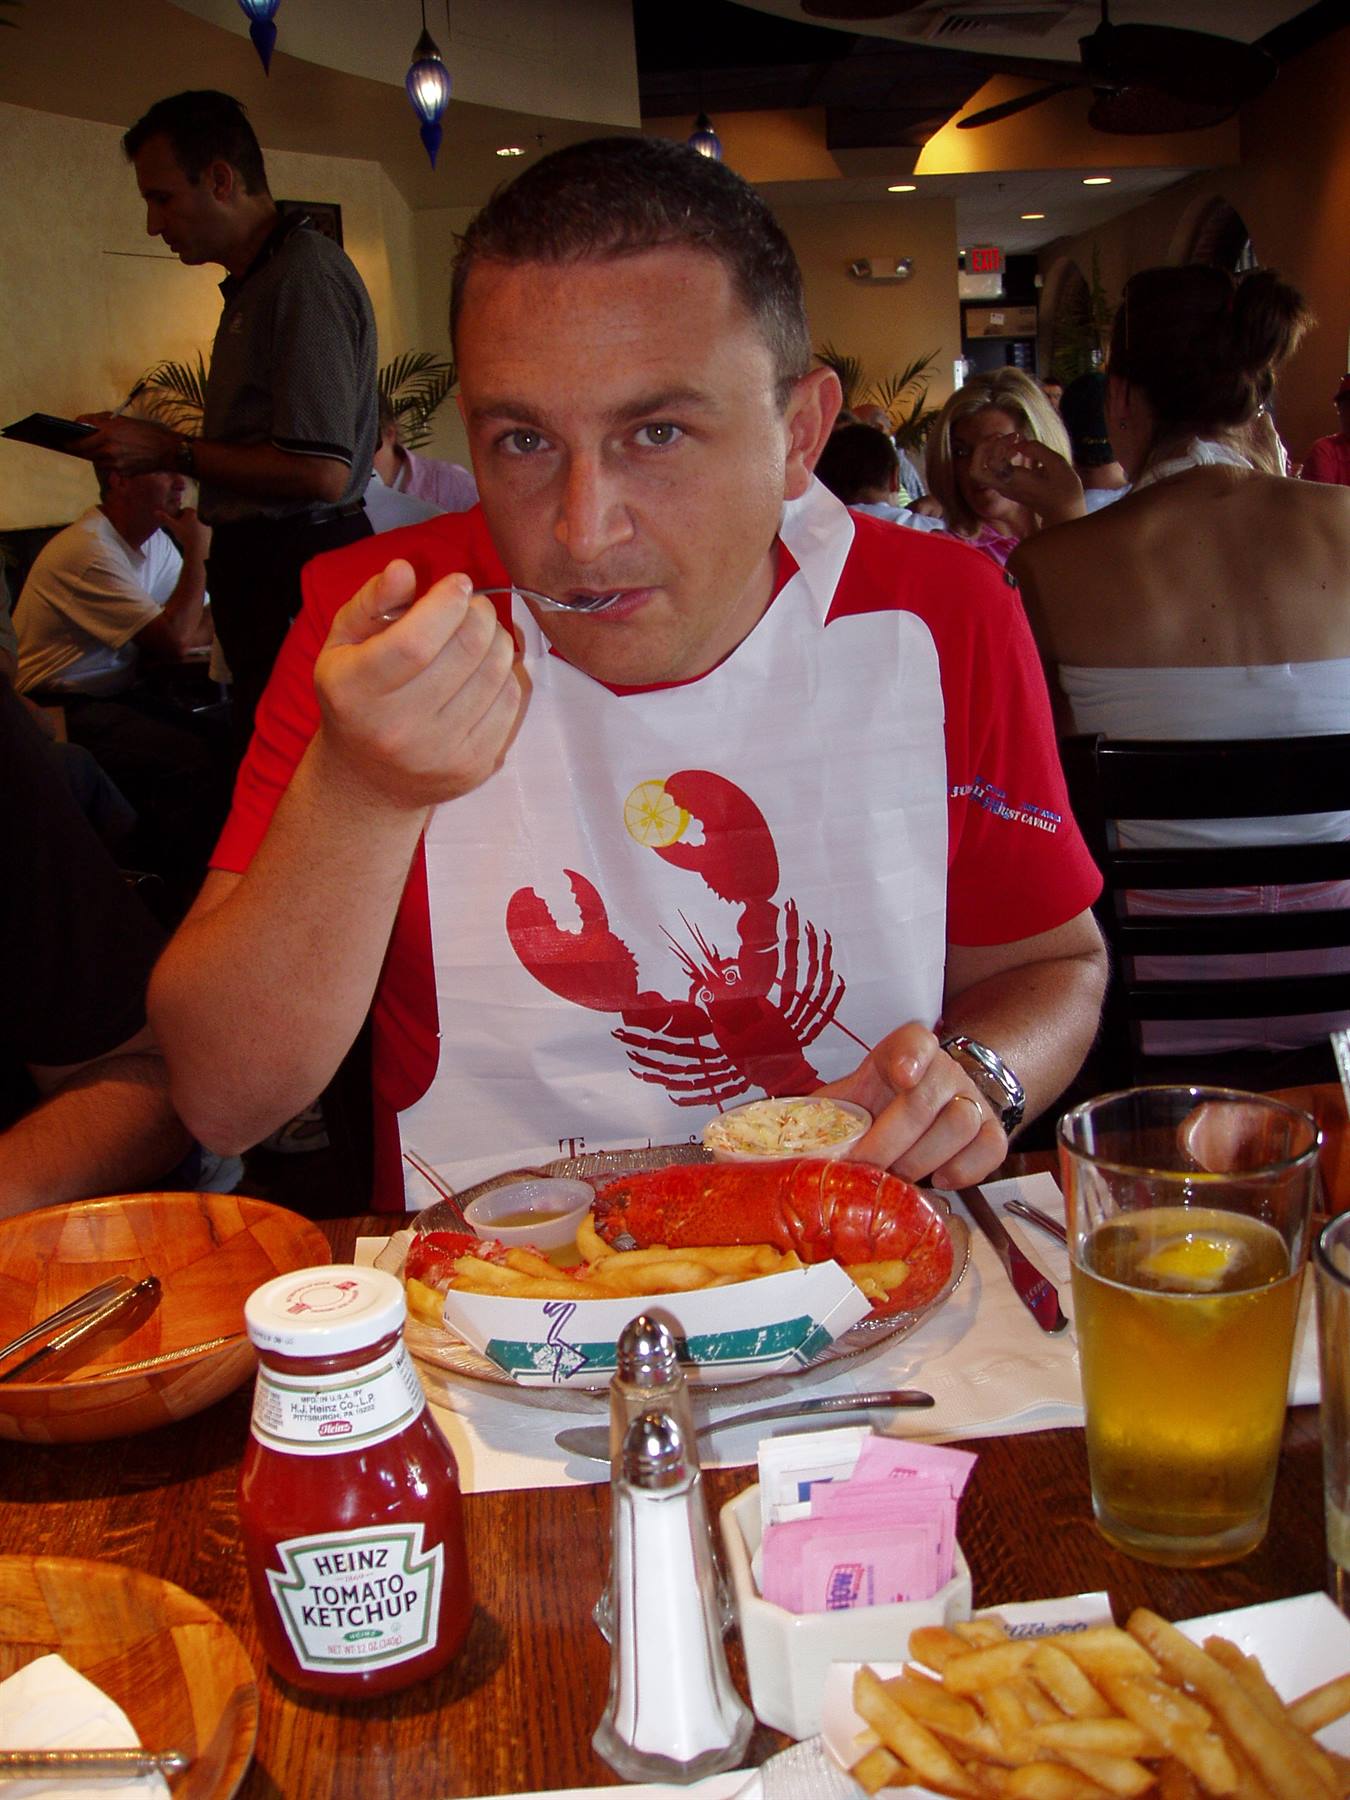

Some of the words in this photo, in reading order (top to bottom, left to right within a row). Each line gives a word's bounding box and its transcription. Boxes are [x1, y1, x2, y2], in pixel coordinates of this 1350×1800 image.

[972, 246, 999, 272] EXIT
[998, 801, 1021, 821] JUST
[1021, 813, 1057, 833] CAVALLI
[309, 1404, 337, 1414] Heinz
[319, 1422, 352, 1435] Heinz
[313, 1549, 389, 1576] HEINZ
[310, 1574, 404, 1606] TOMATO
[302, 1590, 418, 1628] KETCHUP
